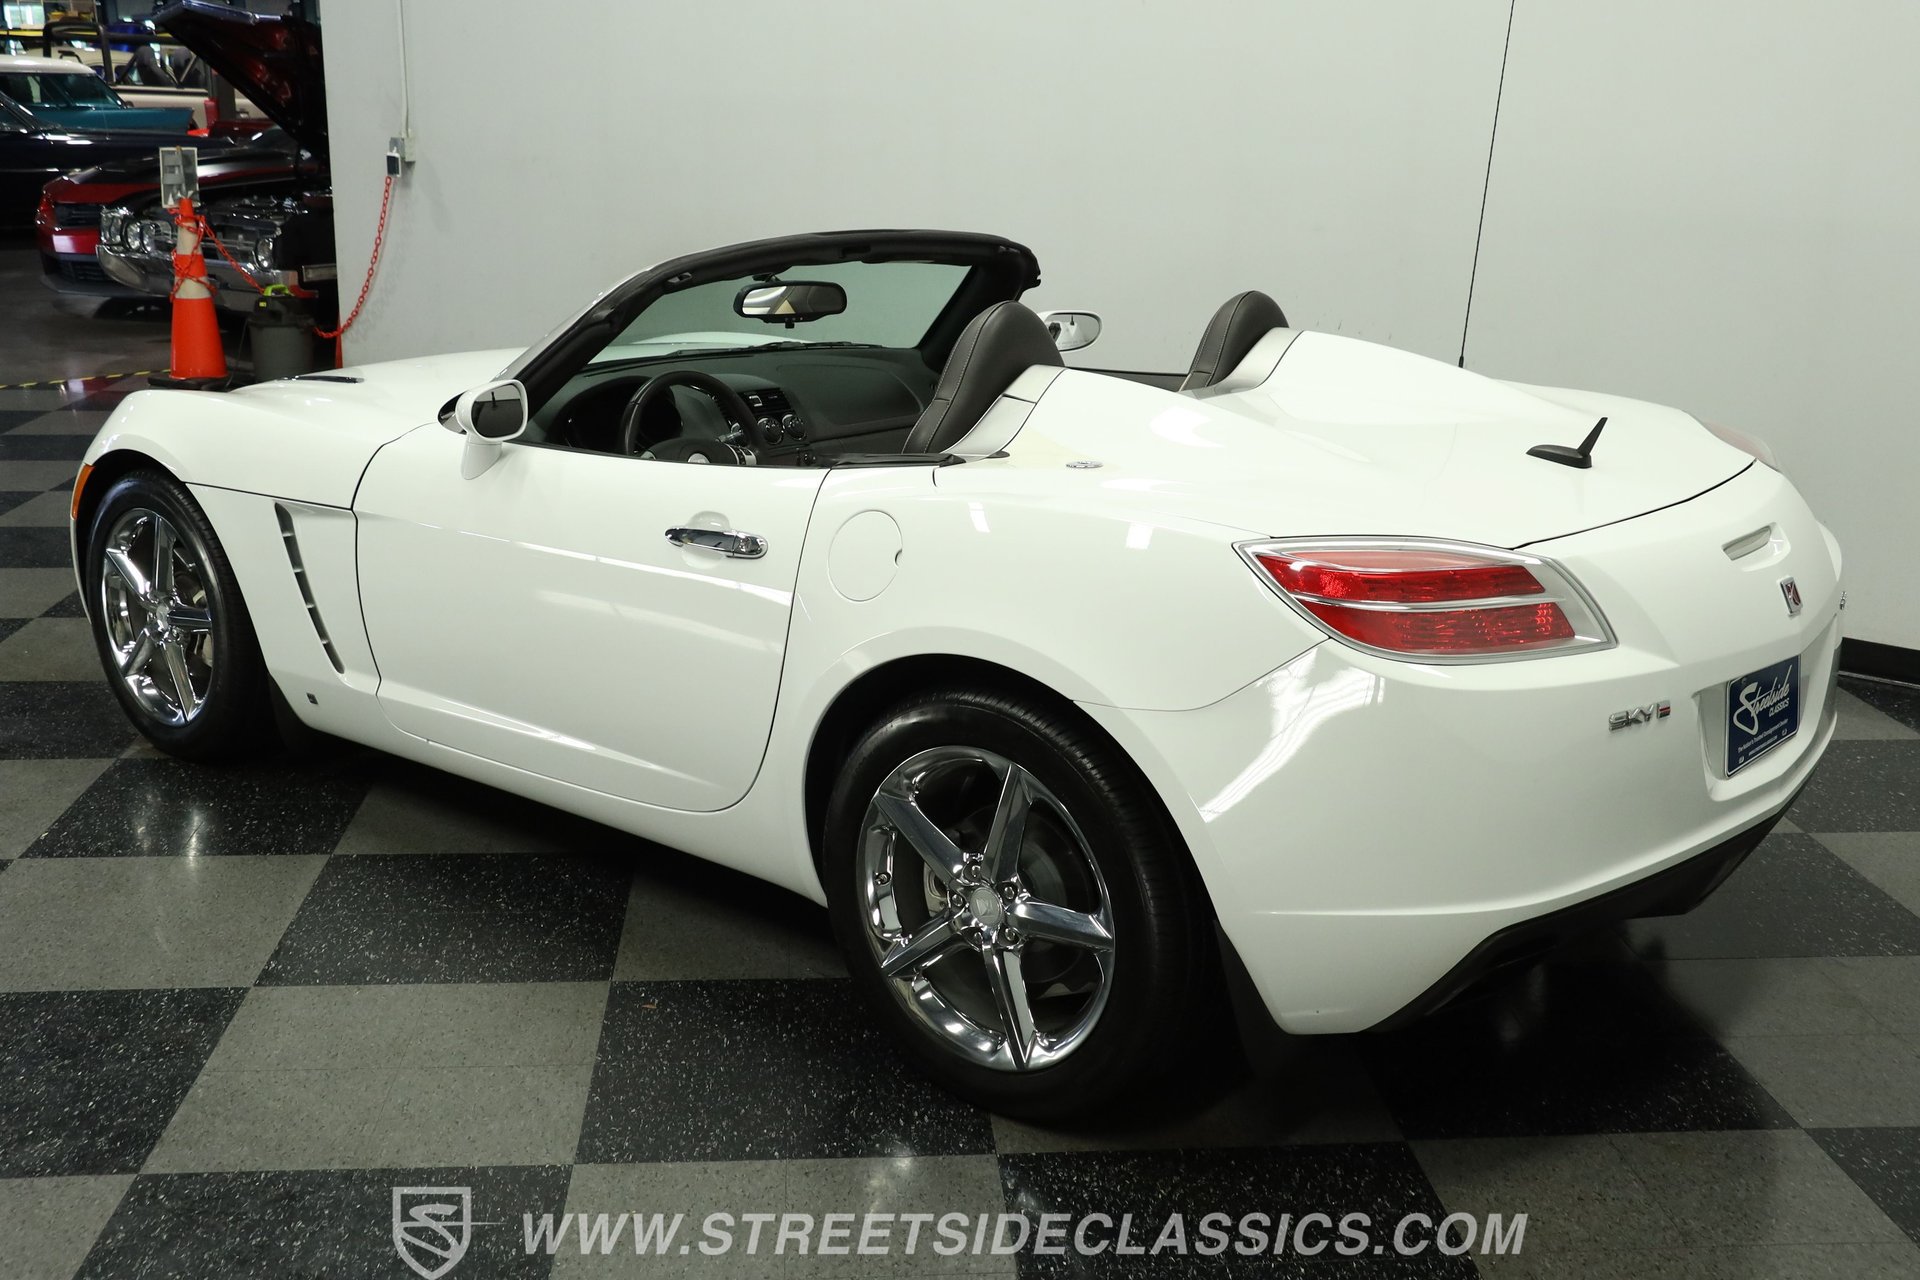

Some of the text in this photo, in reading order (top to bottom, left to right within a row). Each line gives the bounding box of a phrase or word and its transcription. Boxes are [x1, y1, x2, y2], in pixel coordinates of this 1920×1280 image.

[1733, 664, 1792, 735] Streetside
[1768, 697, 1790, 717] CLASSICS
[1608, 702, 1655, 731] SKY
